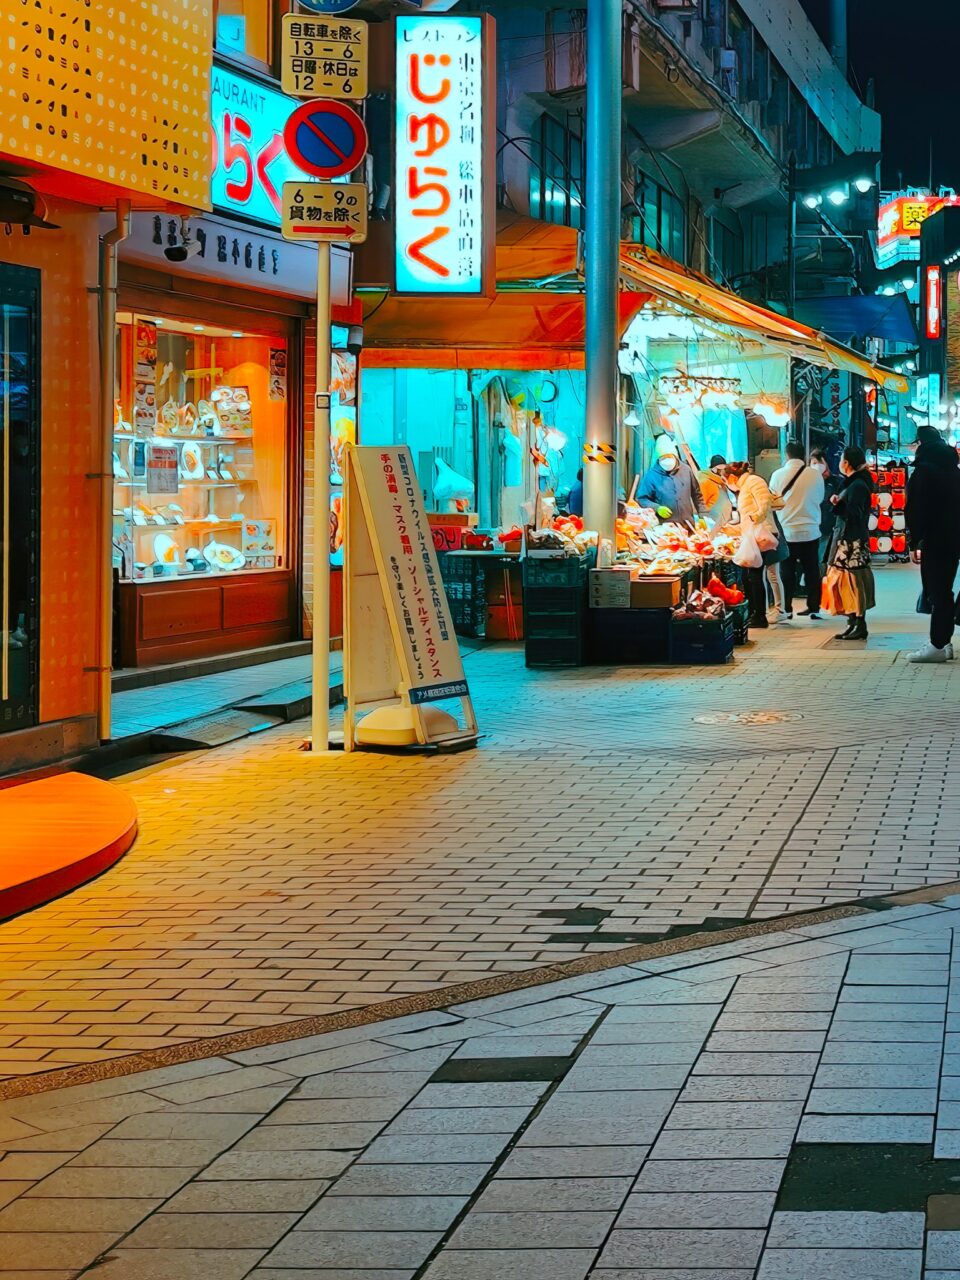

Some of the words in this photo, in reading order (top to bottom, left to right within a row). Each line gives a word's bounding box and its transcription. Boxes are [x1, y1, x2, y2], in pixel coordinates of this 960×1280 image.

[290, 22, 361, 42] 自転車を除く
[406, 53, 452, 278] じゅらく
[289, 206, 361, 223] 貨物を除く
